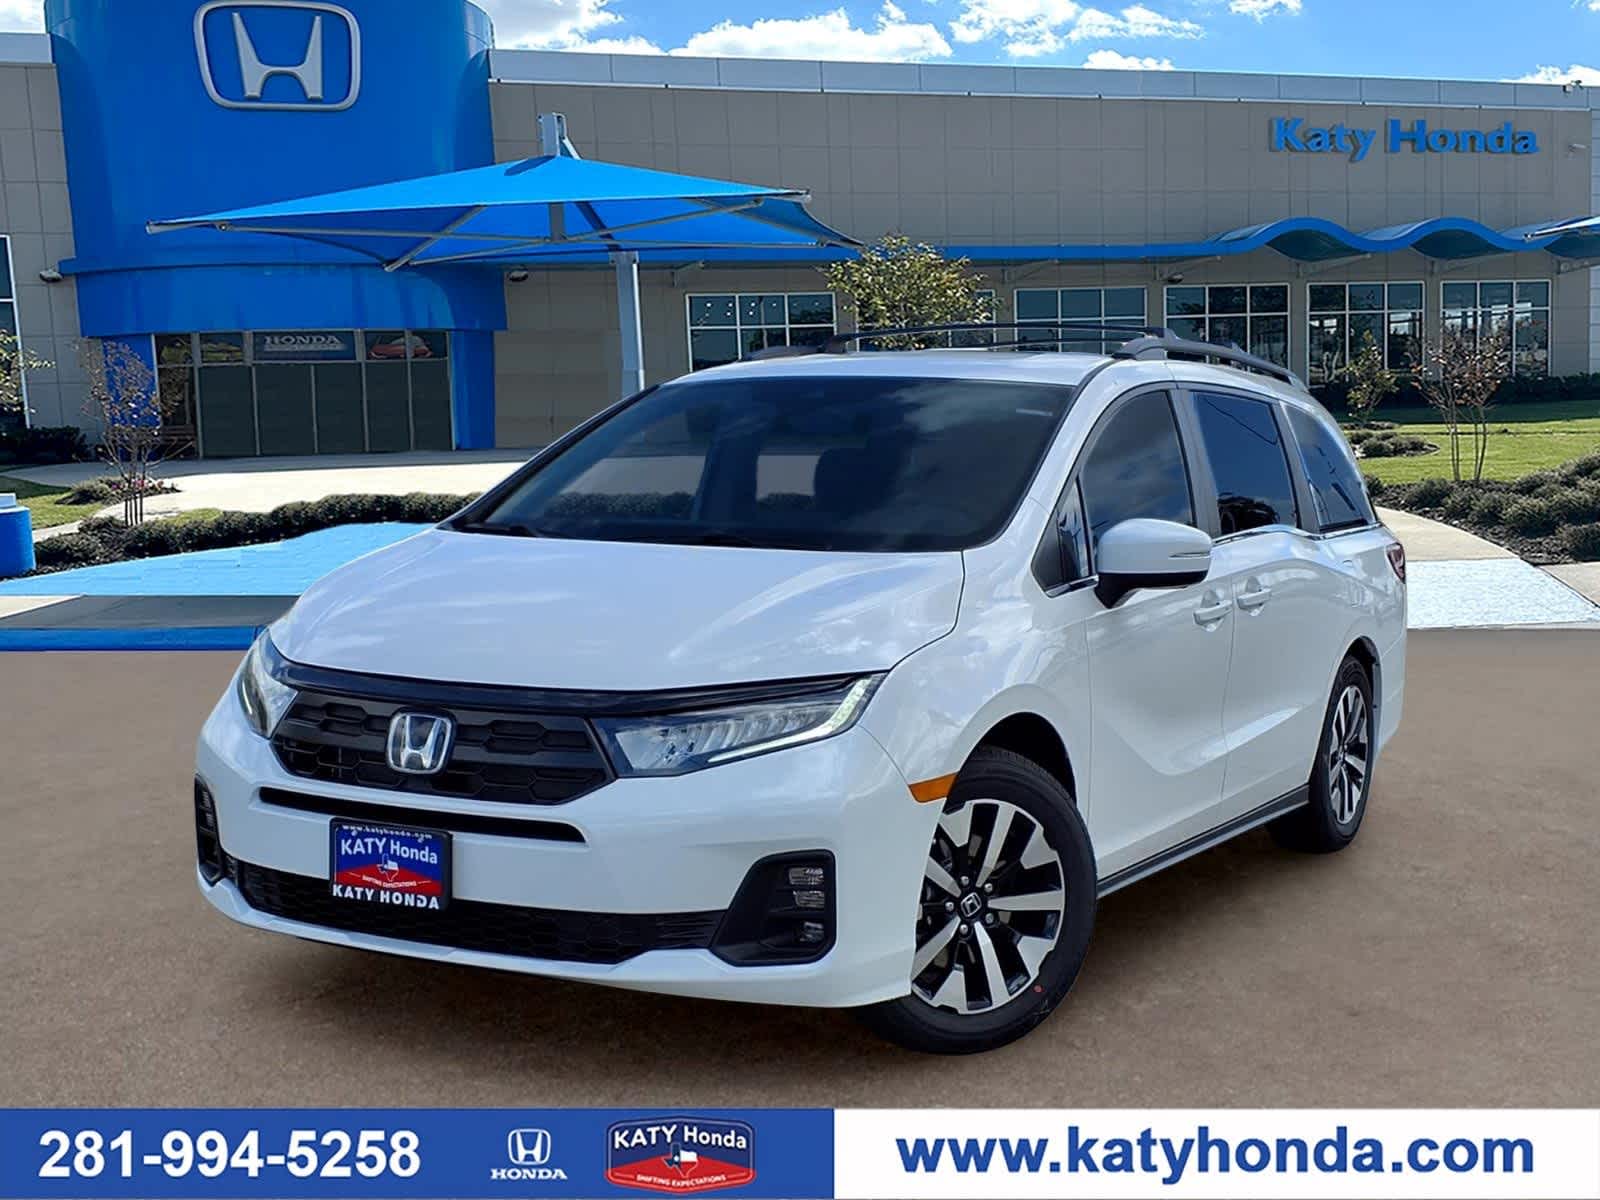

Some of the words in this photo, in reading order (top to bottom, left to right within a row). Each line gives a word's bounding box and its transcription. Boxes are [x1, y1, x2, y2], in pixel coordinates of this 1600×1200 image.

[1271, 117, 1376, 162] Katy
[1386, 119, 1539, 154] Honda
[264, 335, 343, 344] HONDA
[341, 838, 387, 856] KATY
[390, 839, 438, 864] Honda
[332, 884, 375, 901] KATY
[380, 891, 440, 910] HONDA
